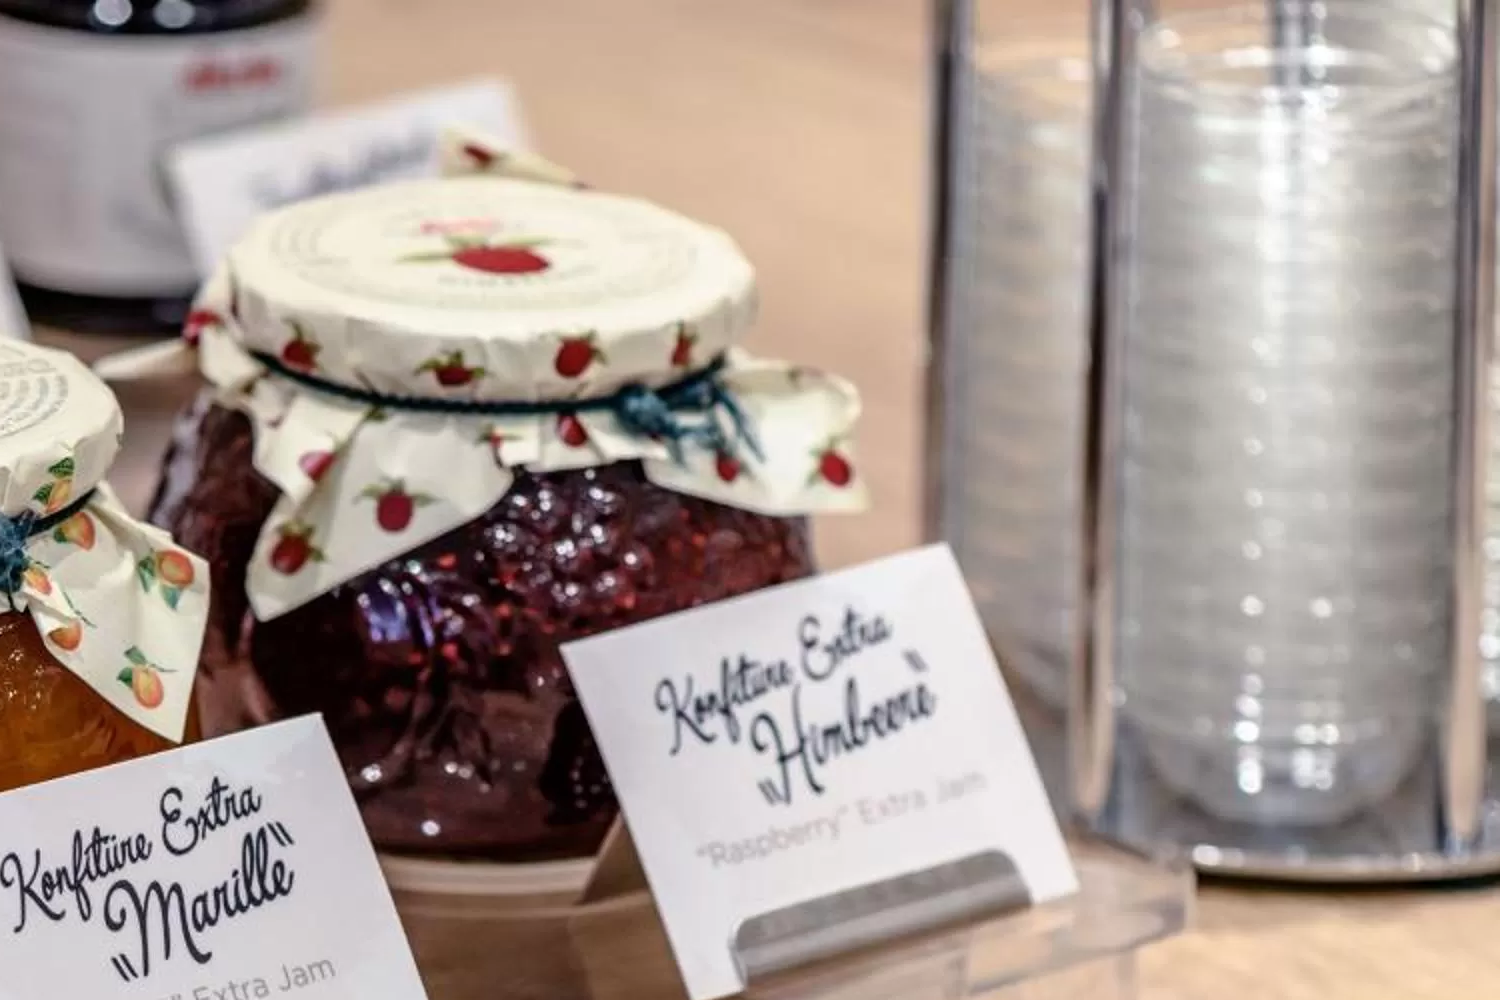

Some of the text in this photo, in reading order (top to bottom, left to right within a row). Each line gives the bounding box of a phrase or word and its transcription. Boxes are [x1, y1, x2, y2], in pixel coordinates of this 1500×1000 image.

[796, 603, 894, 682] Extra
[0, 775, 263, 933] Konfitüre Extra
[278, 955, 336, 992] Jam
